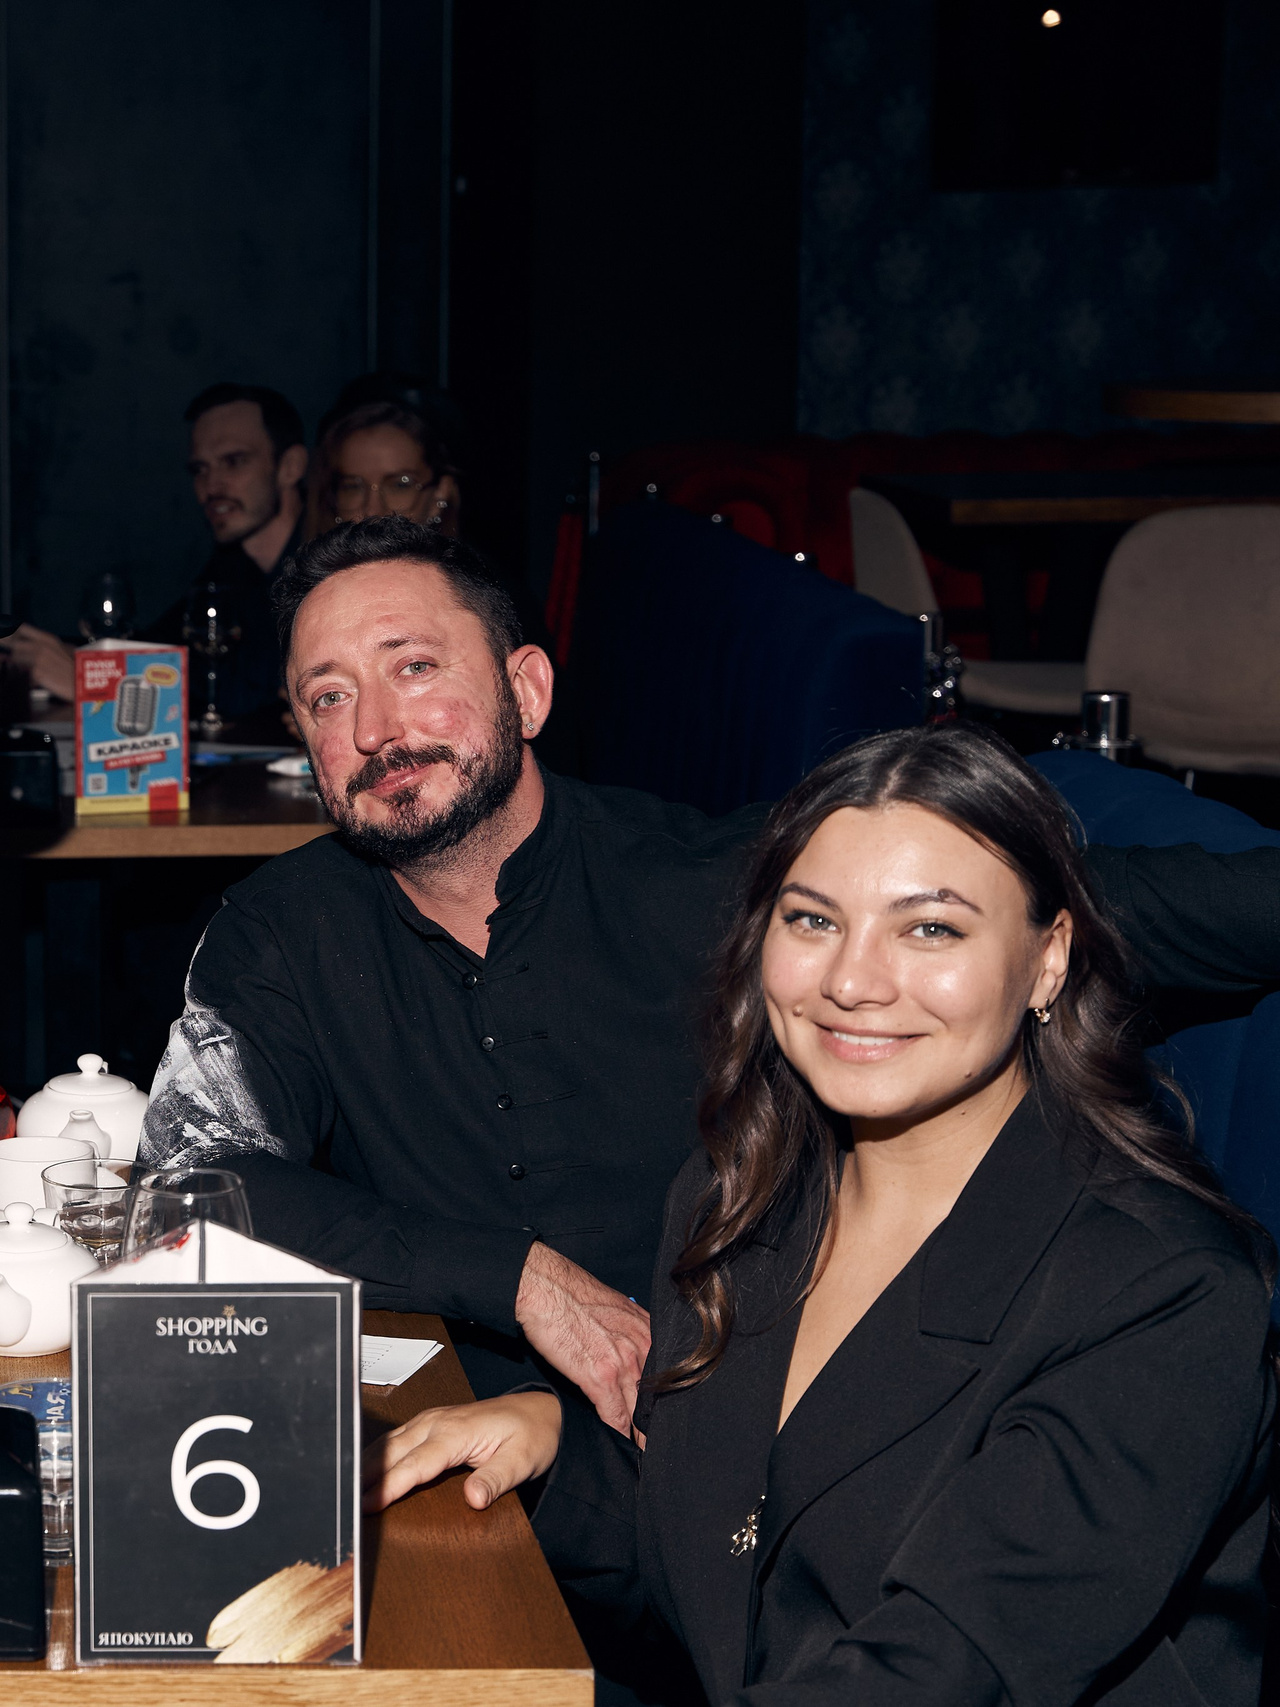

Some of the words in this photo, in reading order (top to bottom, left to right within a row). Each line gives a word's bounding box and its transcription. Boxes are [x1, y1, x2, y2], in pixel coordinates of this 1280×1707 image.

[96, 738, 173, 756] КАРАОКЕ
[156, 1315, 268, 1337] SHOPPING
[187, 1338, 238, 1354] ГОДА
[170, 1414, 261, 1531] 6
[98, 1630, 194, 1648] ЯПОКУПАЮ
